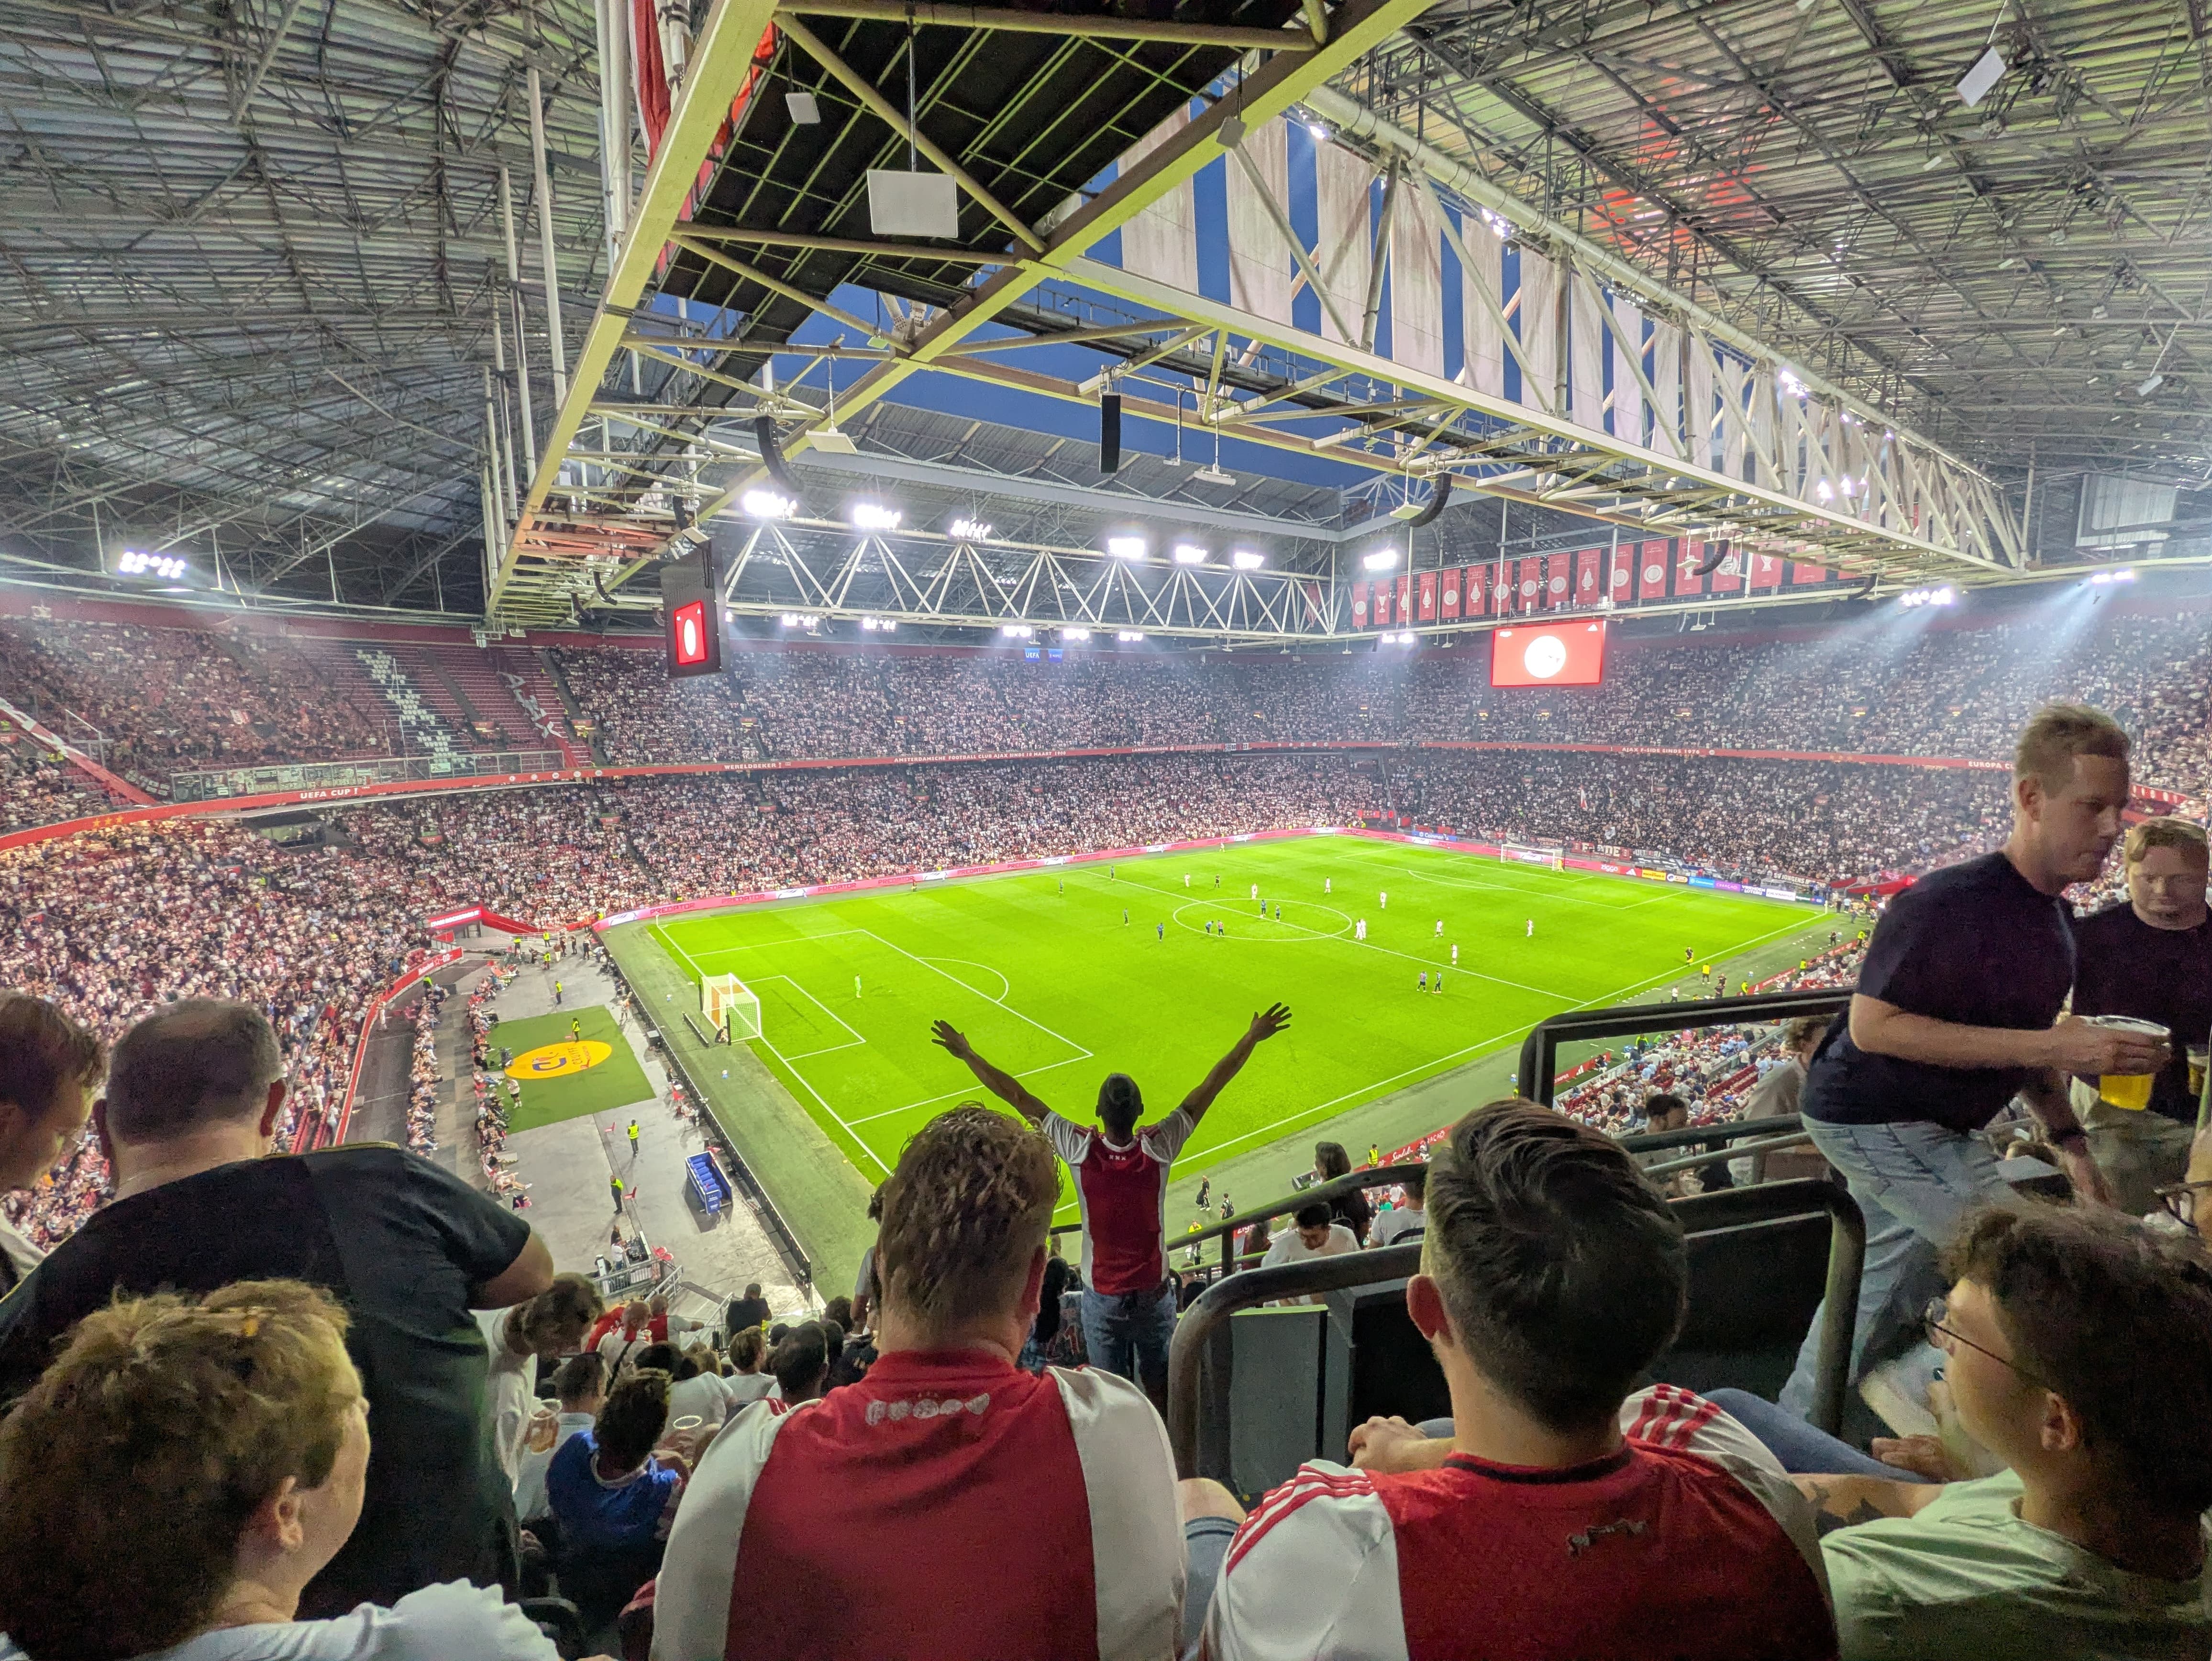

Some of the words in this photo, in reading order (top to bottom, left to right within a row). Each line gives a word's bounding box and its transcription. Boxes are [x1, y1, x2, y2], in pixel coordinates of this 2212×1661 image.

[1968, 761, 2002, 769] EUROPA
[1007, 861, 1038, 869] PREDATOR
[1601, 864, 1618, 872] ziggo
[957, 866, 990, 875] PREDATOR
[878, 876, 914, 885] PREDATOR
[818, 883, 857, 893] PREDATOR
[721, 894, 765, 904] PREDATOR
[650, 902, 696, 915] PREDATOR
